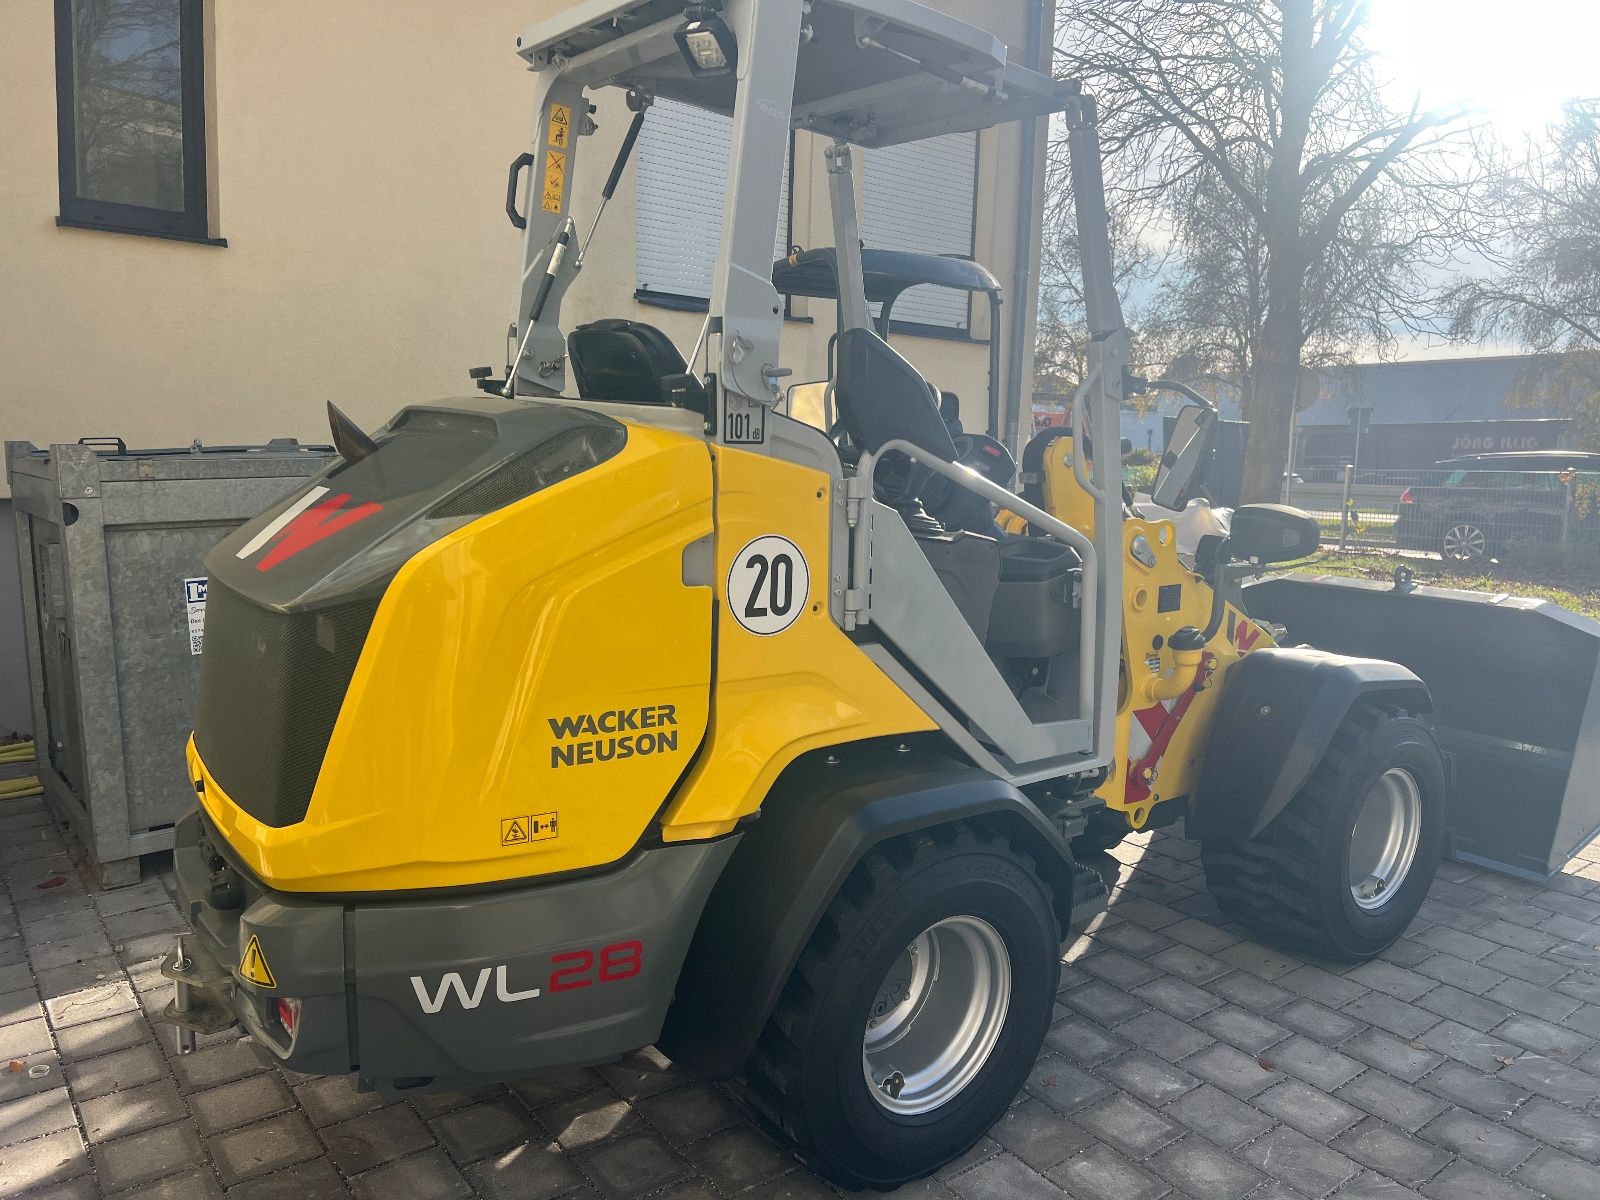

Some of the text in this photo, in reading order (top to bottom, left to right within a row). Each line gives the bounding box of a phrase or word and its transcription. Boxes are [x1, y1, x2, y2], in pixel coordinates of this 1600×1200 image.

[728, 413, 750, 440] 101
[1500, 436, 1539, 450] ILLIG
[744, 553, 793, 618] 20
[547, 704, 677, 740] WACKER
[551, 730, 678, 768] NEUSON
